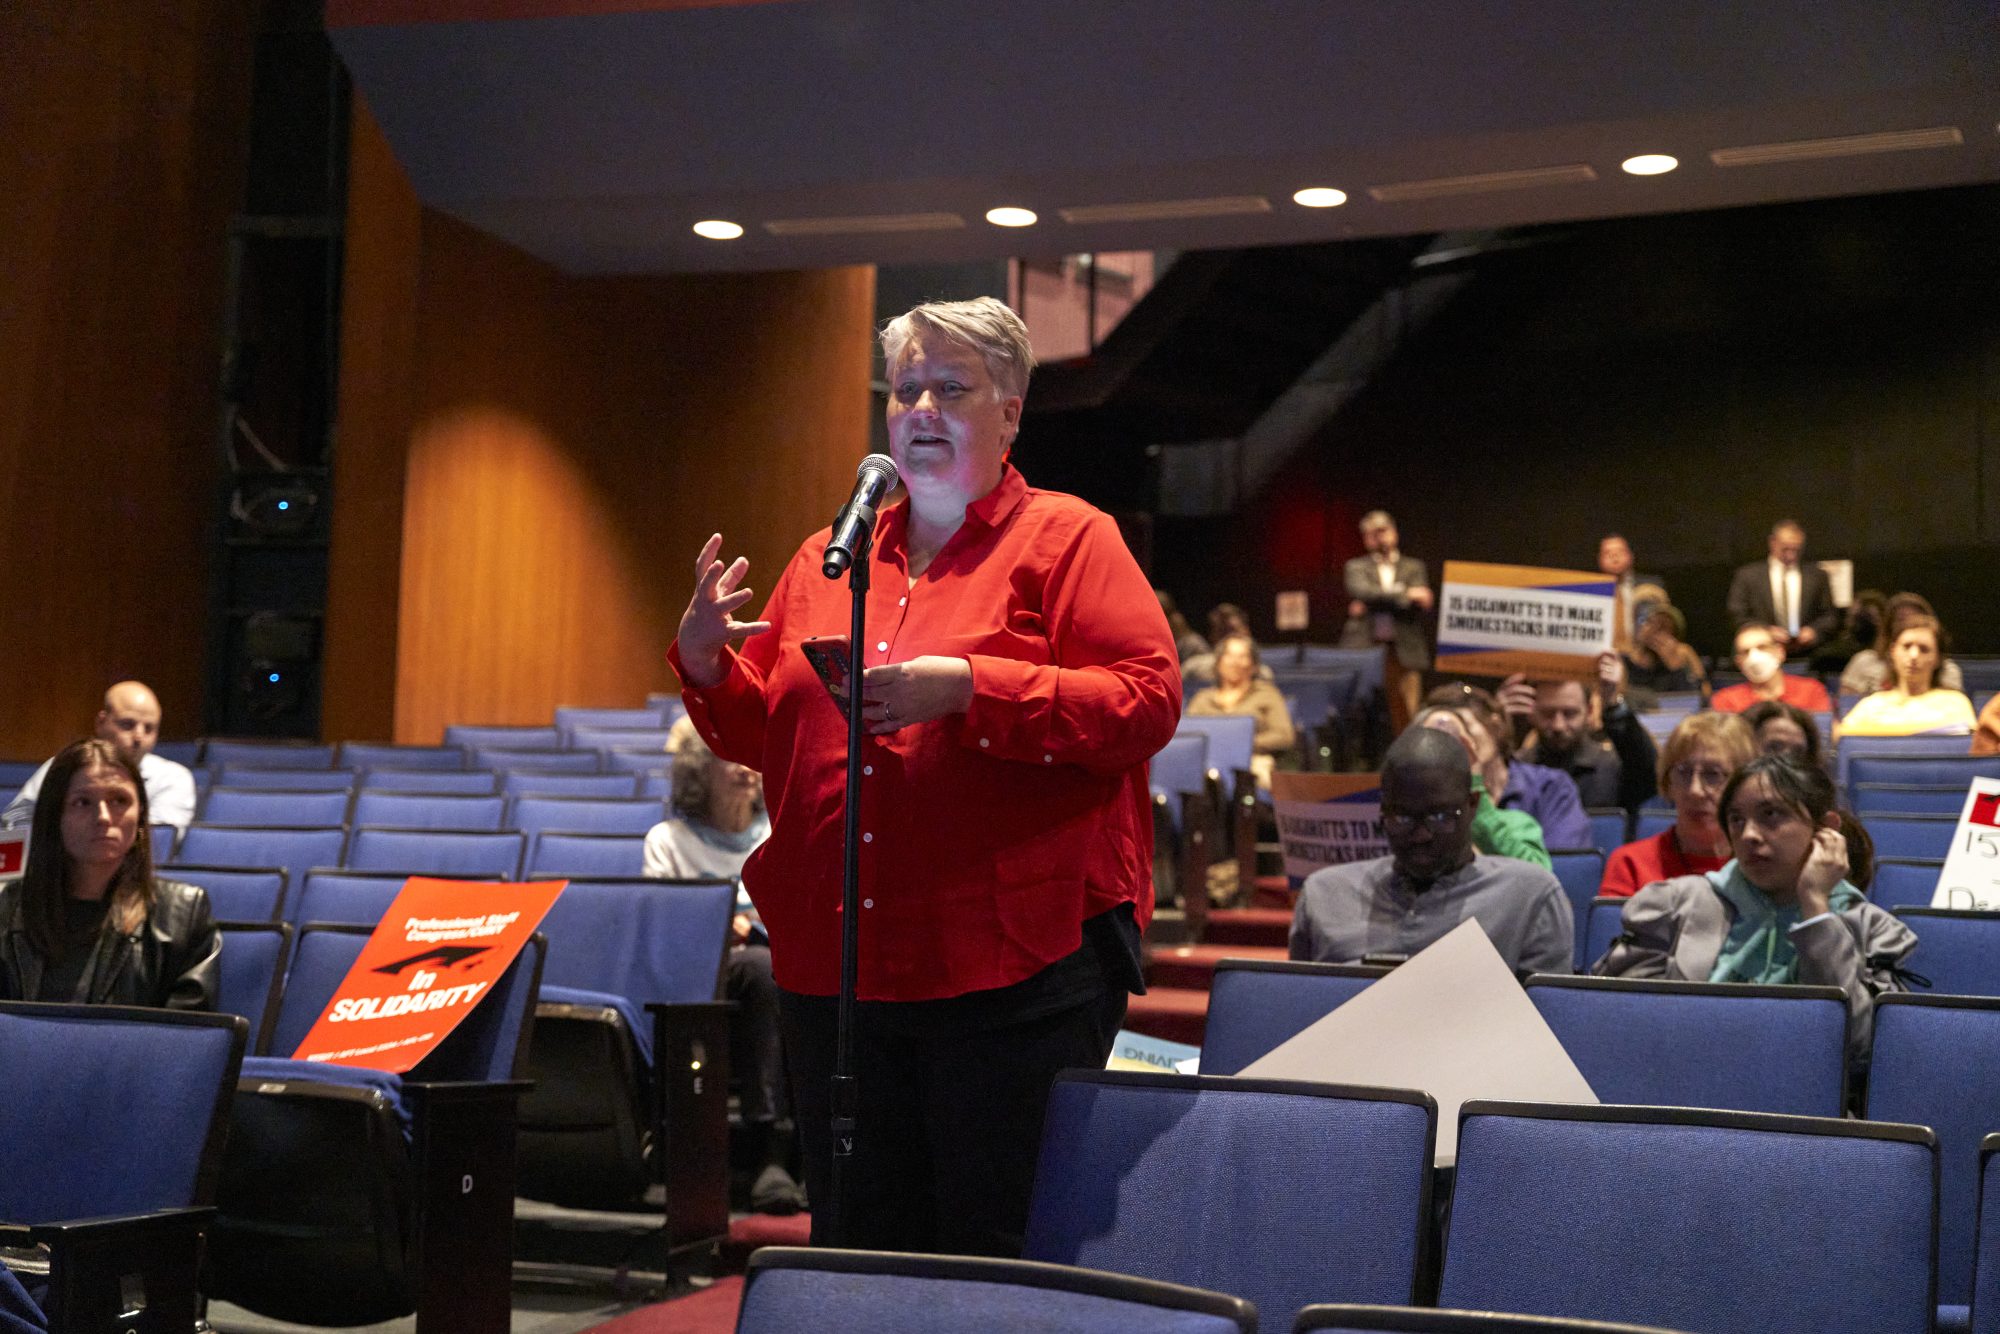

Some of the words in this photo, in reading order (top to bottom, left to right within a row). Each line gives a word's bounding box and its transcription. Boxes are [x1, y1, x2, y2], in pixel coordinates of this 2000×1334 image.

[1548, 603, 1563, 618] TO
[1568, 604, 1603, 622] MAKE
[1447, 616, 1543, 636] SMOKESTACKS
[1547, 624, 1604, 640] HISTORY
[1351, 821, 1370, 839] TO
[408, 970, 437, 991] In
[328, 981, 488, 1022] SOLIDARITY
[462, 1174, 473, 1194] D
